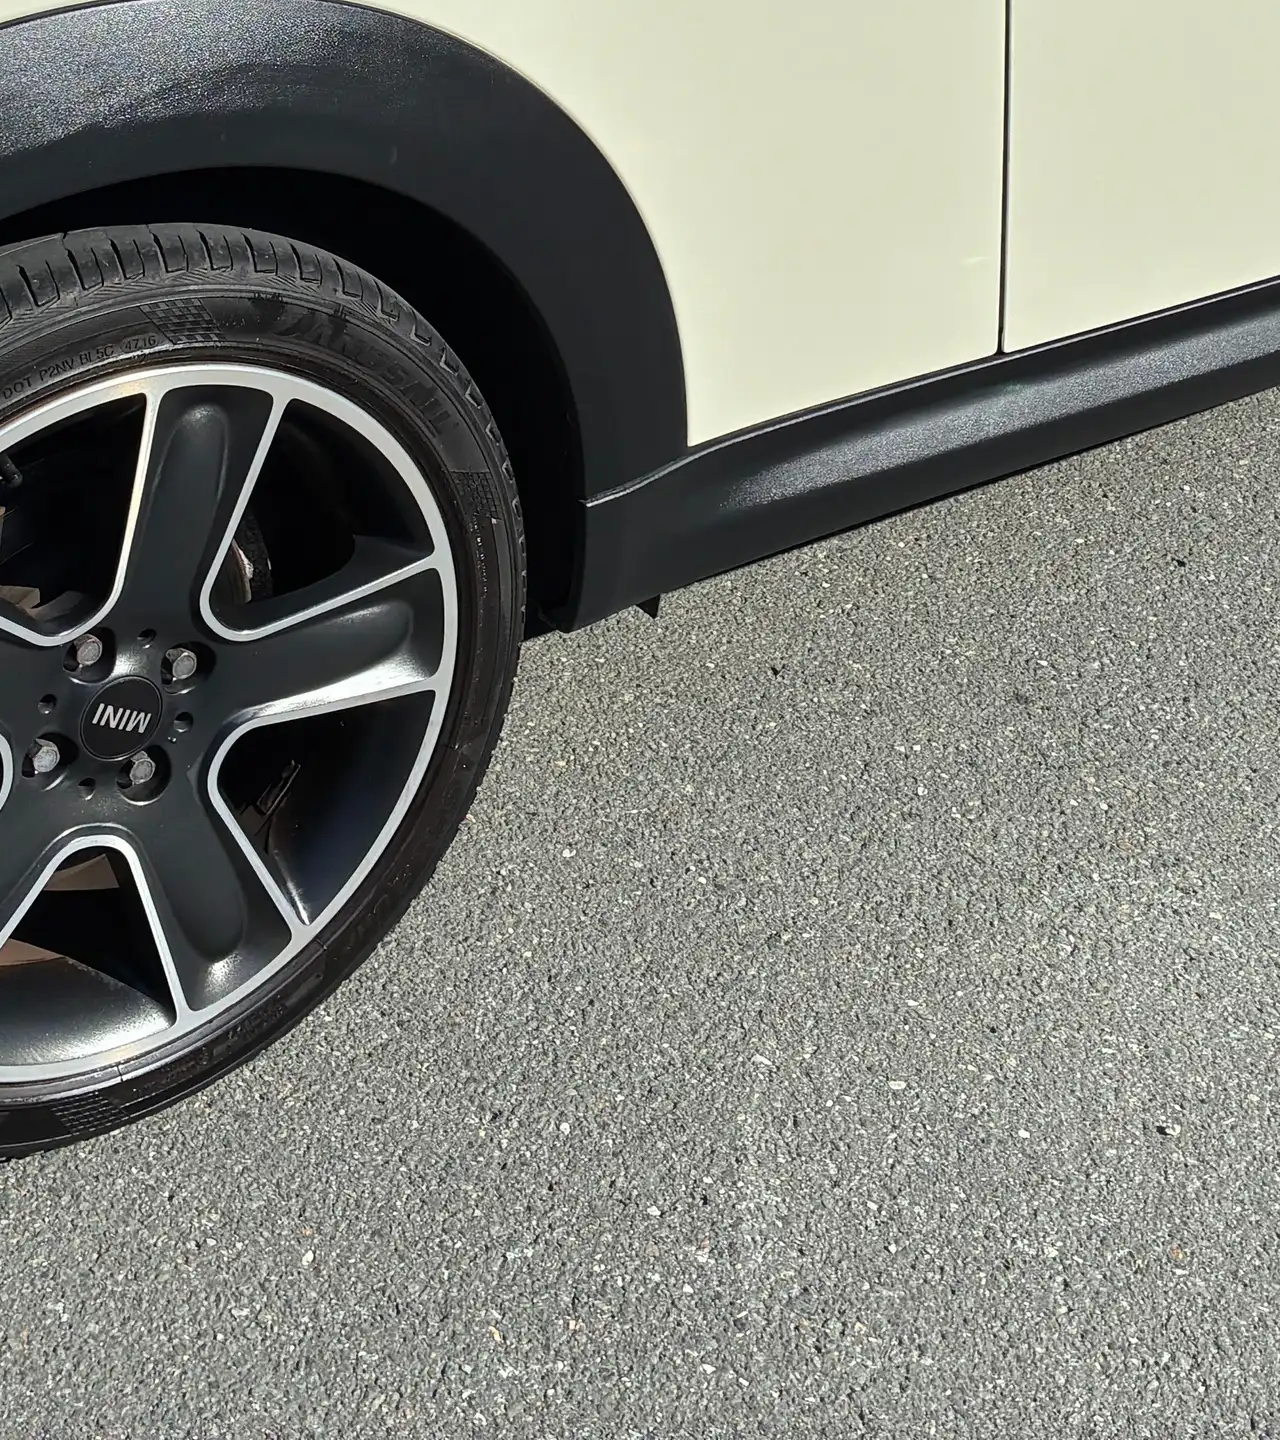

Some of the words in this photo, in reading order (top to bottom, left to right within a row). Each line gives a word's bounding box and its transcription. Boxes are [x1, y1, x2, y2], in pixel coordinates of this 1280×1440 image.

[2, 376, 33, 401] DOT
[123, 334, 157, 353] 4716
[91, 702, 152, 735] MINI
